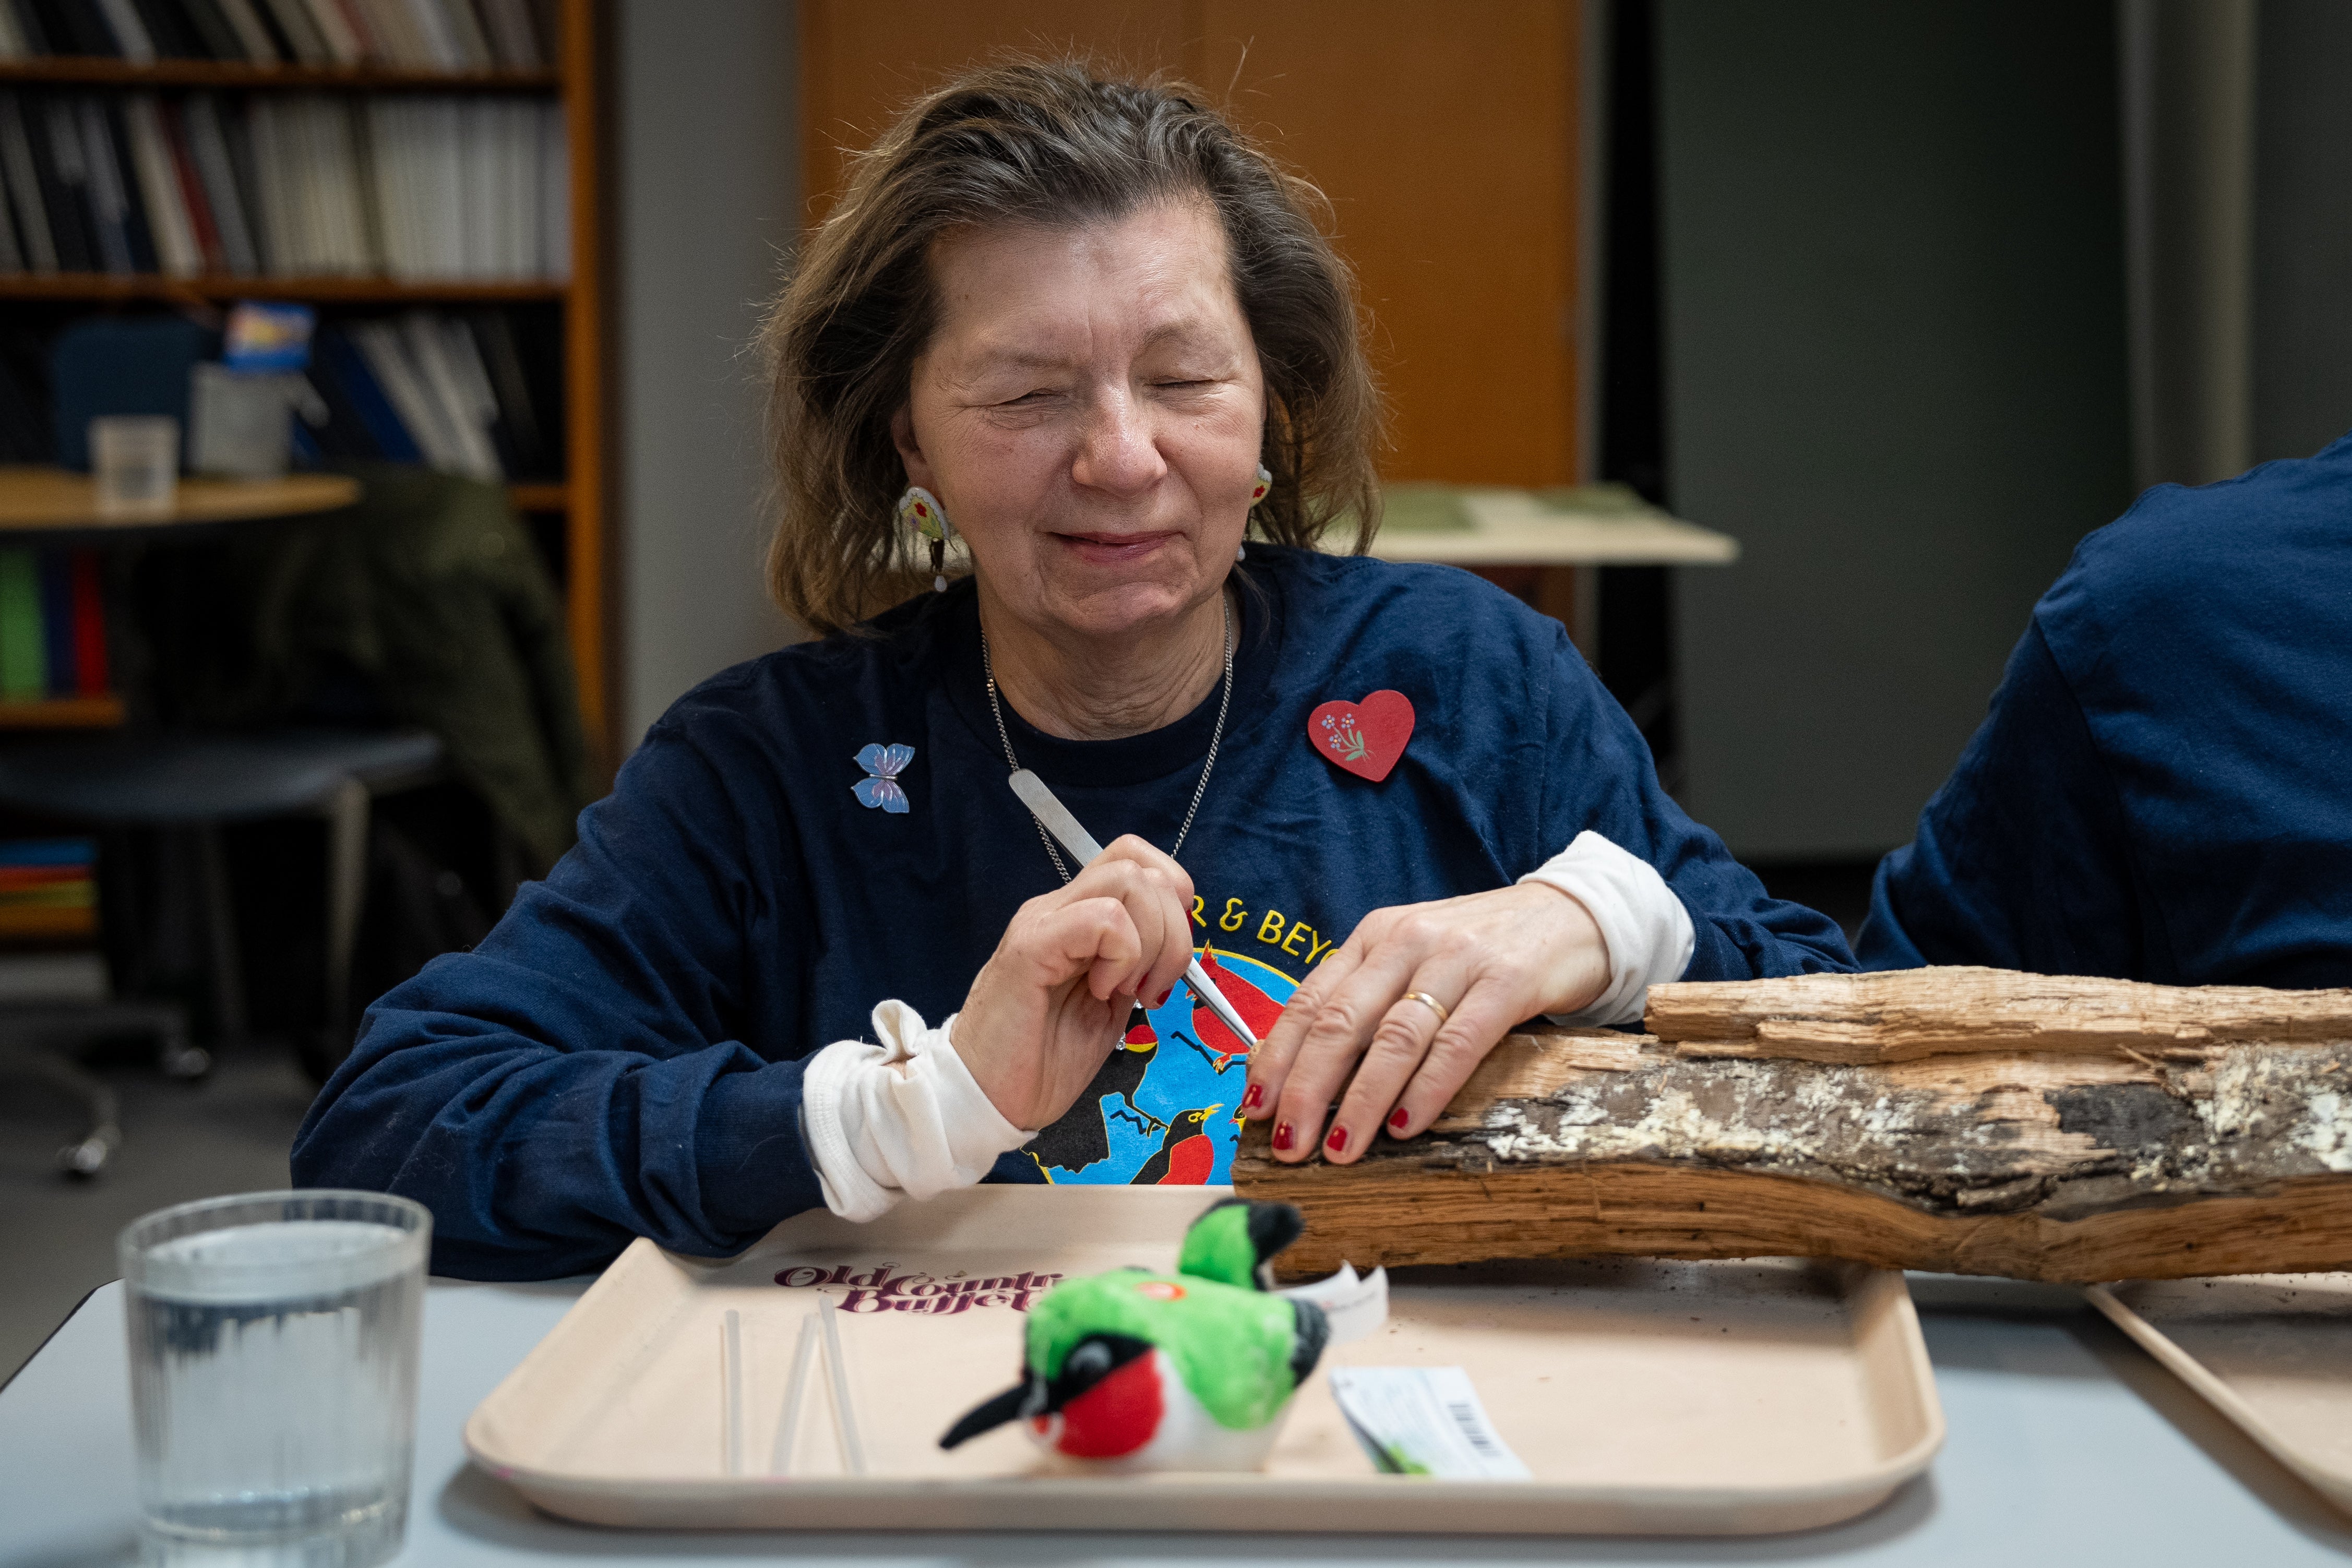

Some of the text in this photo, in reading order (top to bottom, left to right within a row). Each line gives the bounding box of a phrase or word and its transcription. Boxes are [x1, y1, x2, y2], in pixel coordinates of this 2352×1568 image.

[1219, 897, 1248, 932] &
[774, 1263, 1064, 1297] Old Countr
[834, 1289, 1040, 1315] Buffet
